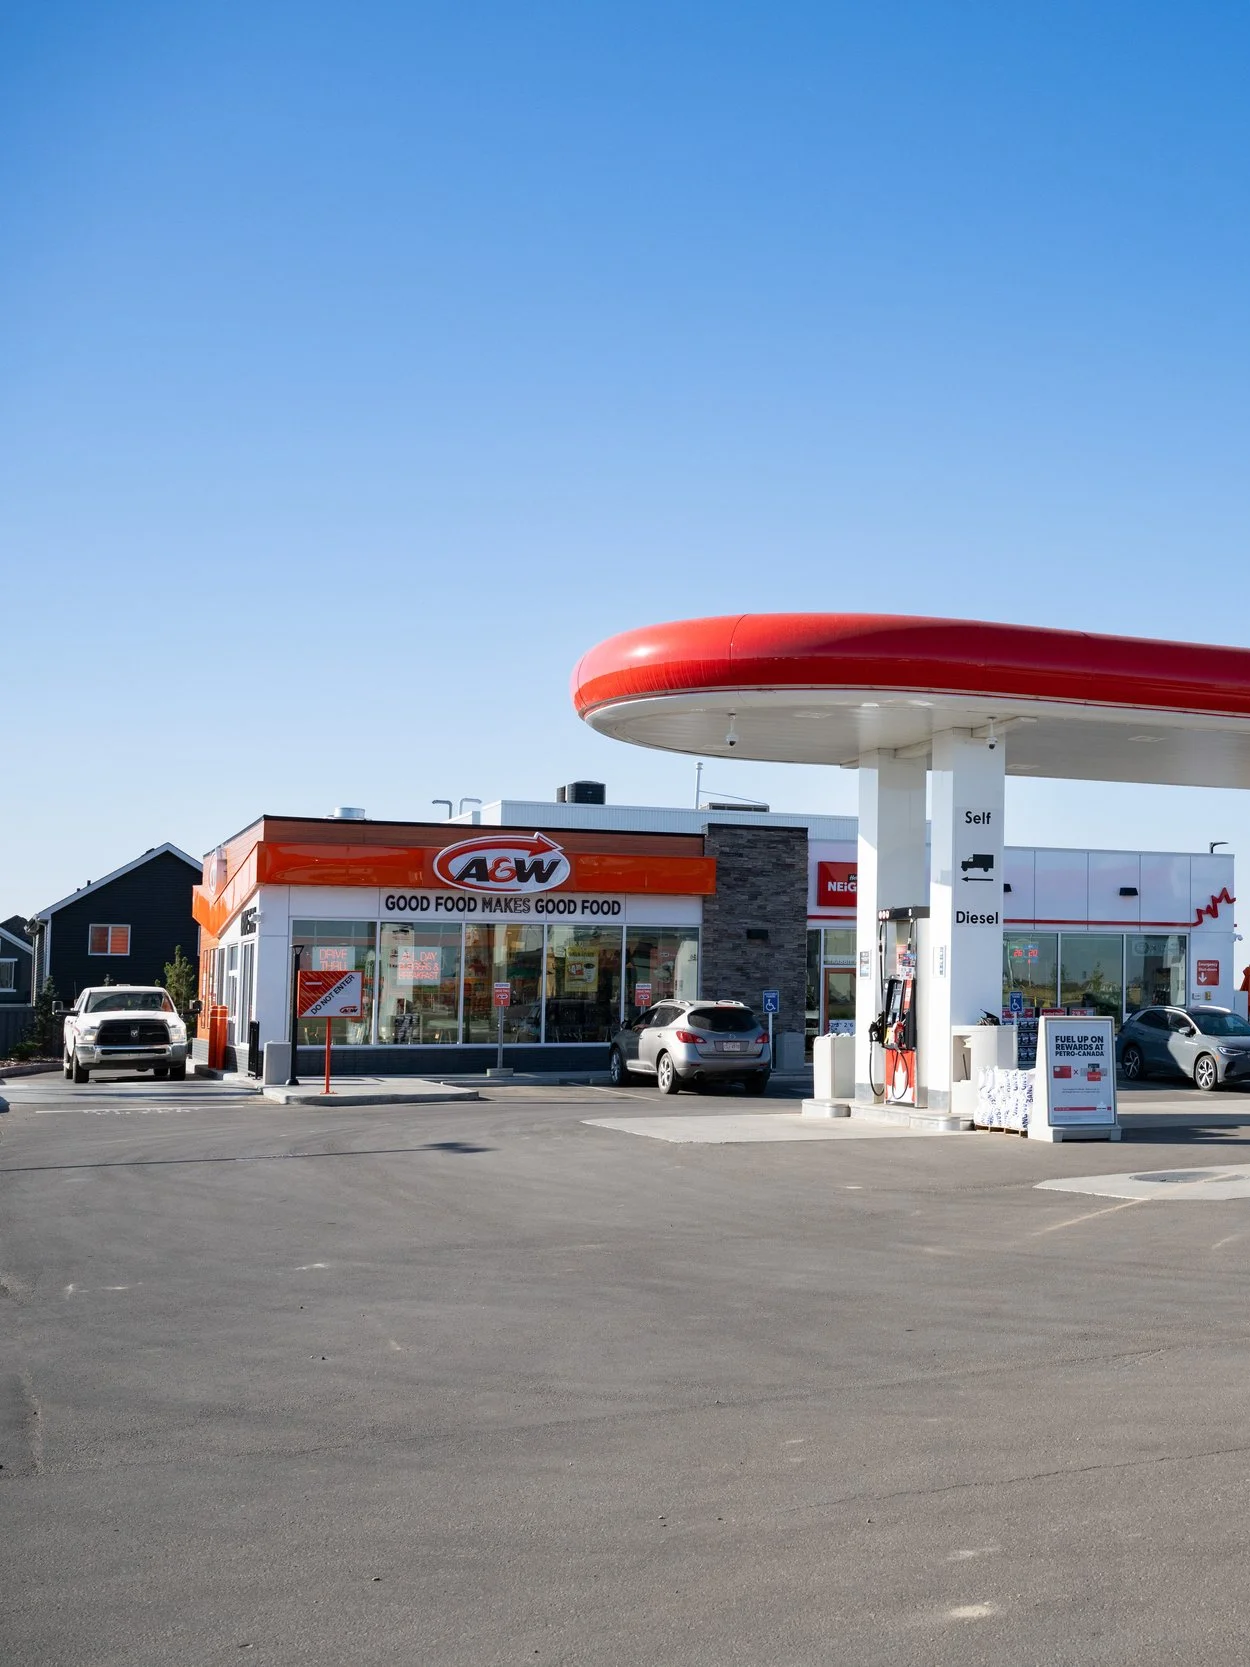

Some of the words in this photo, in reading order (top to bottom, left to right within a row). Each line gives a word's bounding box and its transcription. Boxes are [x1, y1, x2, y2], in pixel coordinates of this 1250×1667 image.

[965, 811, 991, 824] Self
[454, 856, 561, 883] A&W
[385, 895, 430, 912] GOOD
[435, 897, 477, 913] FOOD
[482, 897, 531, 914] MAKES
[535, 898, 577, 915] GOOD
[581, 900, 621, 915] FOOD
[956, 911, 999, 924] Diesel
[310, 1004, 322, 1015] DO
[320, 991, 335, 1006] NOT
[333, 974, 355, 995] ENTER
